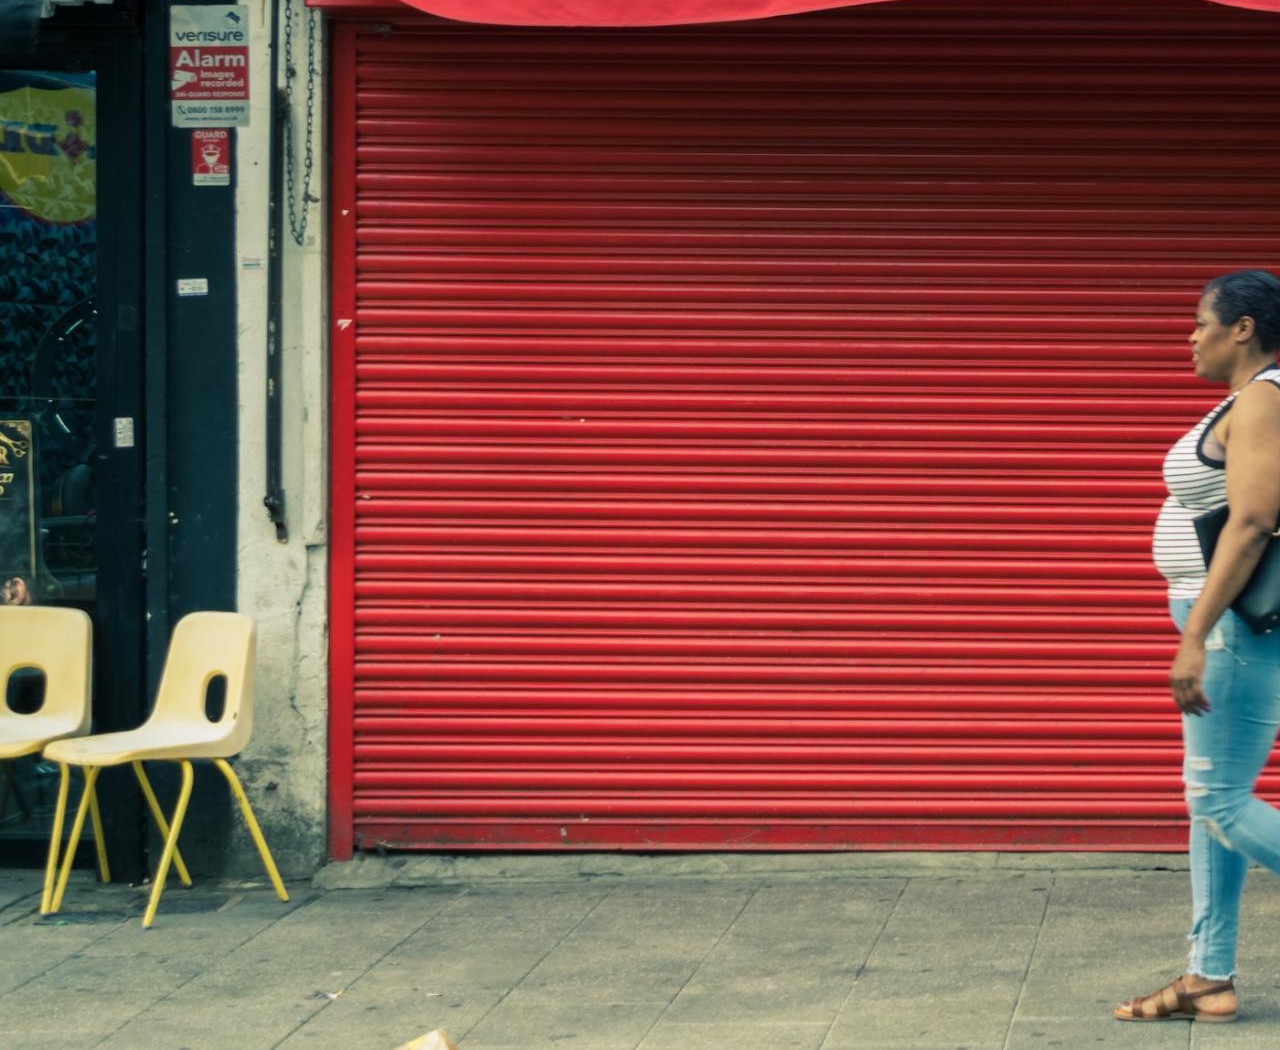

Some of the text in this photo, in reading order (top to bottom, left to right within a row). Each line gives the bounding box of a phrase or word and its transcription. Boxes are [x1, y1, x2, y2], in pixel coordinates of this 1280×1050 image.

[175, 31, 244, 42] verisure
[176, 49, 245, 67] Alarm
[200, 70, 235, 81] Images
[200, 78, 245, 87] recorded
[194, 131, 228, 139] GUARD
